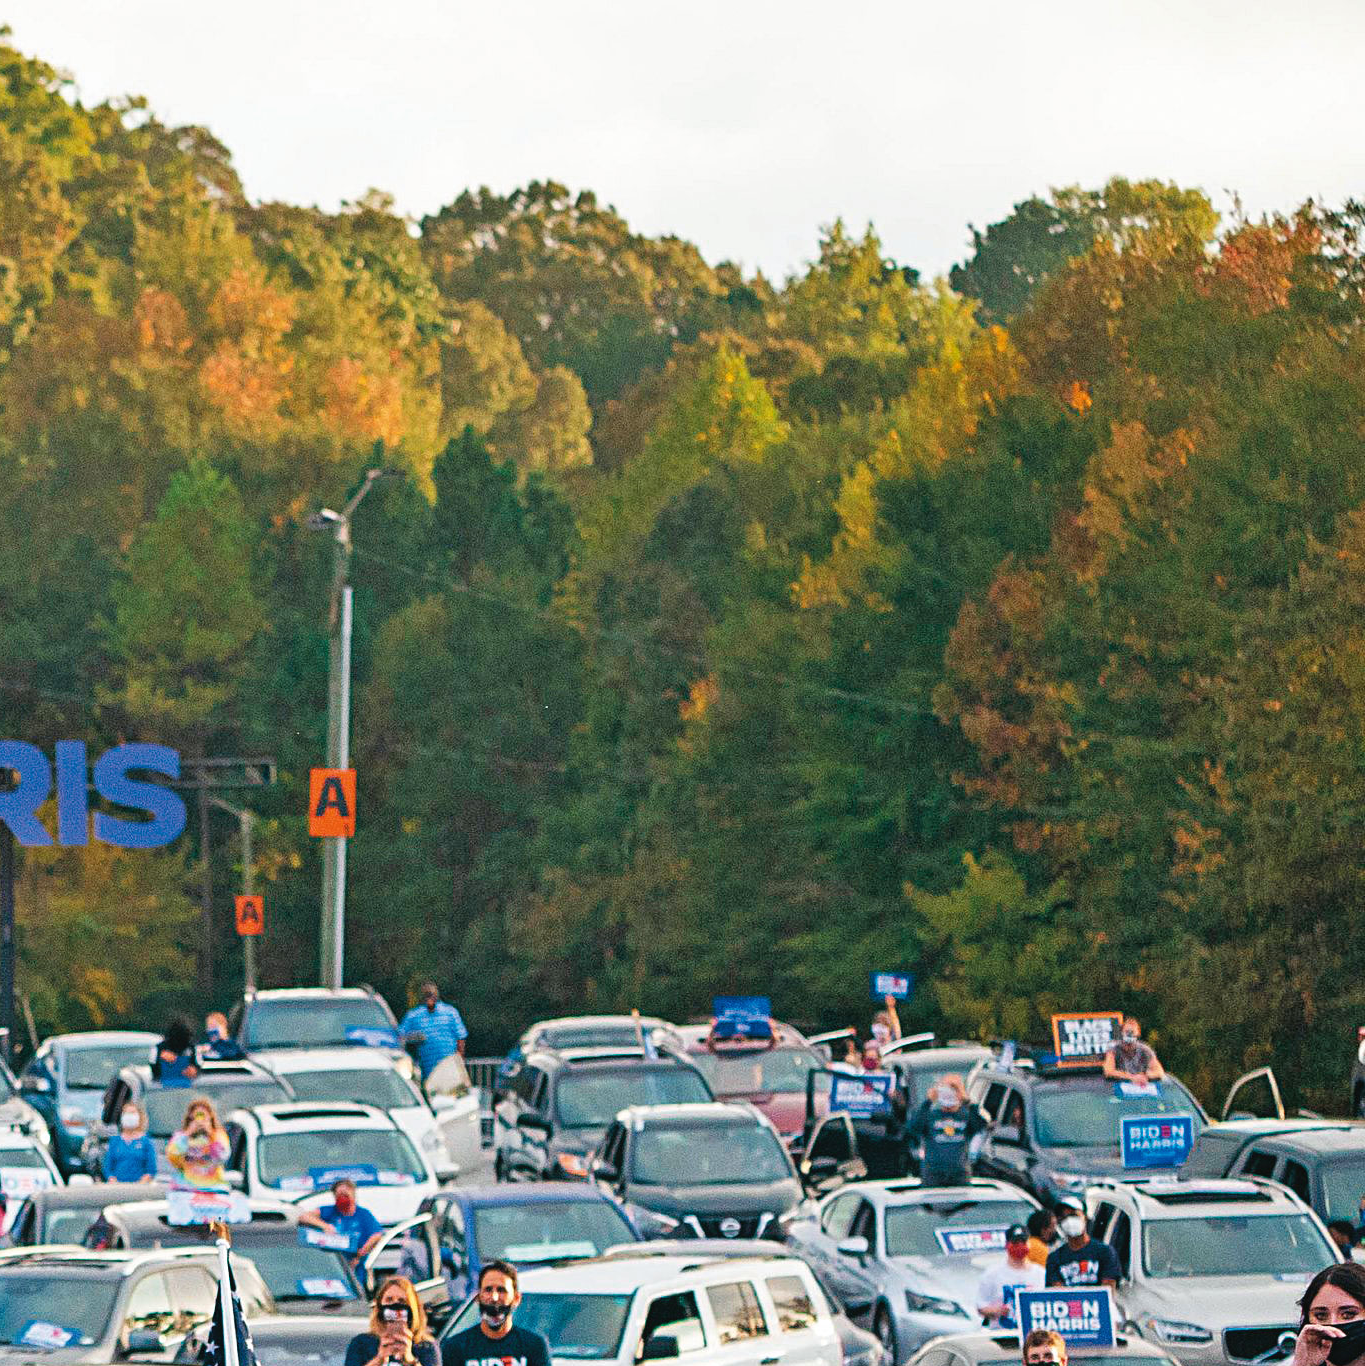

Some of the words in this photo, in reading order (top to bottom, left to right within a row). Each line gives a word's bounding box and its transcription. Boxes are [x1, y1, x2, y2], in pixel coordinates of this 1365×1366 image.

[314, 775, 350, 818] A
[239, 901, 259, 927] A
[1129, 1123, 1185, 1139] BIDEN
[1130, 1138, 1185, 1150] HARRIS
[1030, 1299, 1100, 1318] BIDEN
[1031, 1318, 1101, 1331] HARRIS
